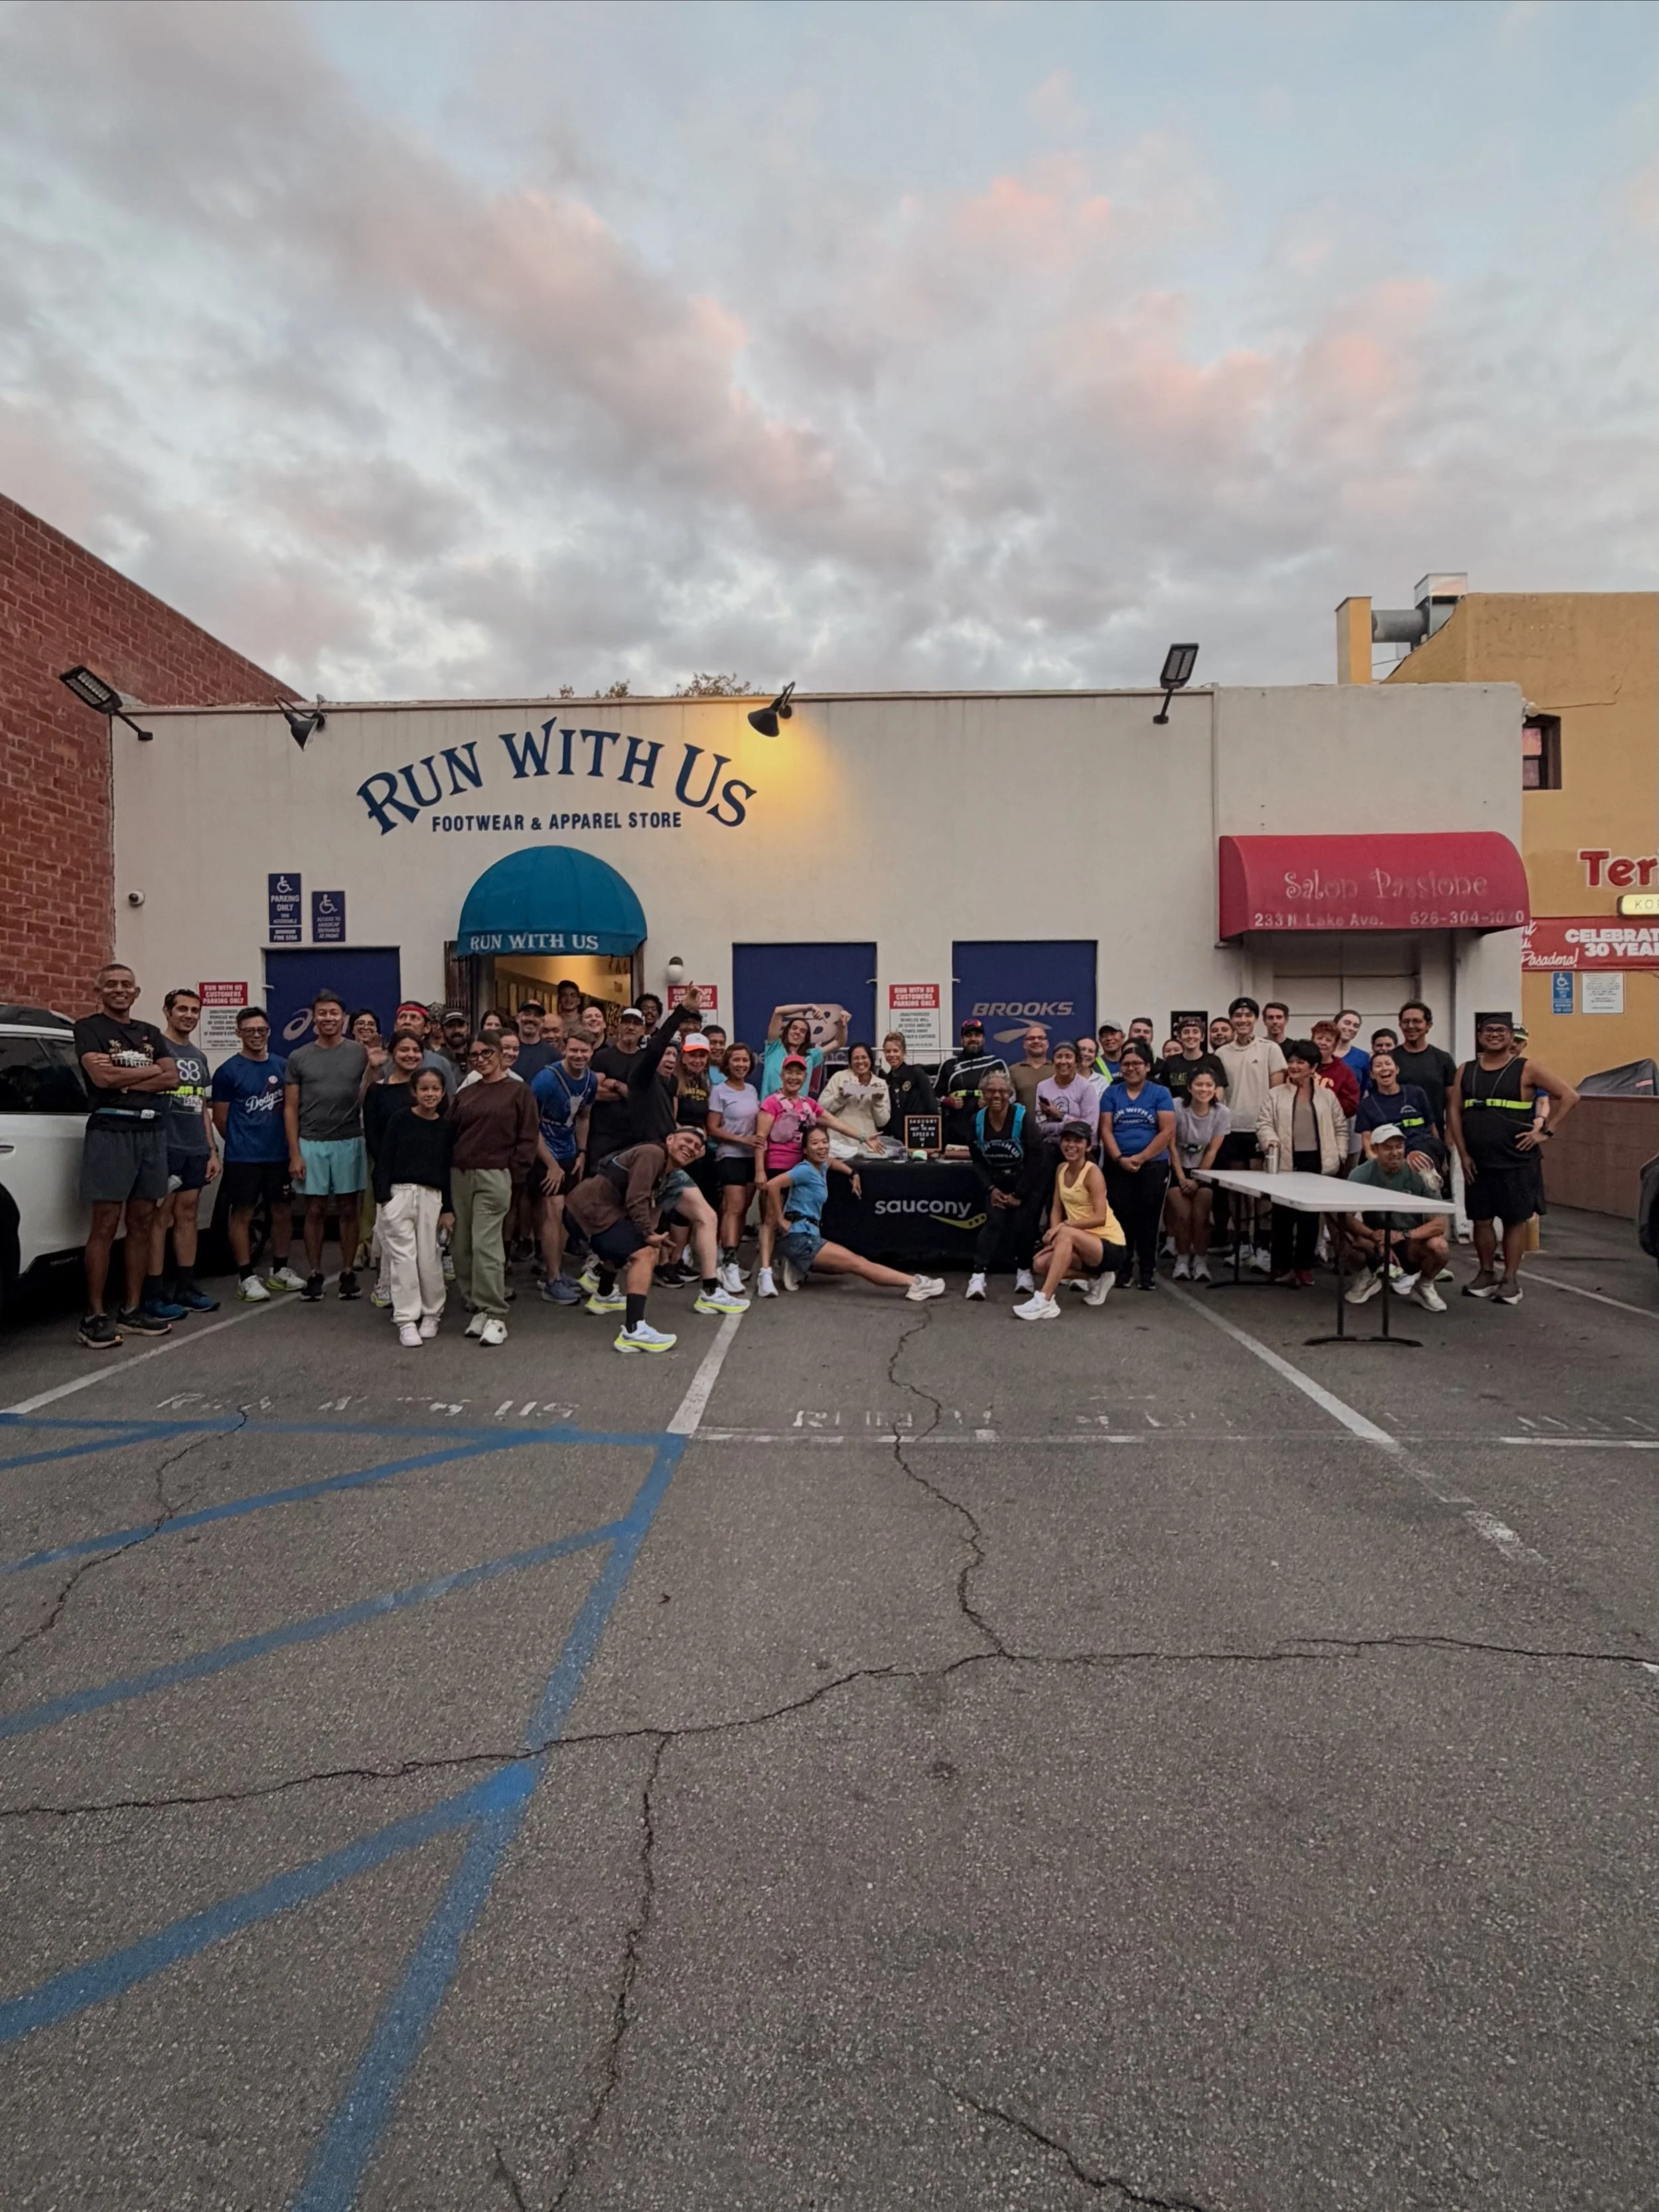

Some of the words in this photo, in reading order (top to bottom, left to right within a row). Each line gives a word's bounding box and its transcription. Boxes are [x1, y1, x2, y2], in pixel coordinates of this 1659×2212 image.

[356, 741, 482, 835] RUN
[499, 717, 664, 788] WITH
[675, 743, 757, 826] US
[432, 814, 524, 832] FOOTWEAR
[531, 817, 541, 830] &
[549, 813, 622, 830] APPAREL
[628, 812, 682, 828] STORE
[271, 894, 300, 903] PARKING
[1254, 913, 1283, 926] 233
[470, 934, 502, 950] RUN
[507, 932, 566, 950] WITH
[572, 934, 599, 950] US
[1584, 942, 1610, 957] 30
[1521, 948, 1579, 968] Pasadena!
[972, 1001, 1074, 1016] BROOKS
[874, 1199, 972, 1218] saucony
